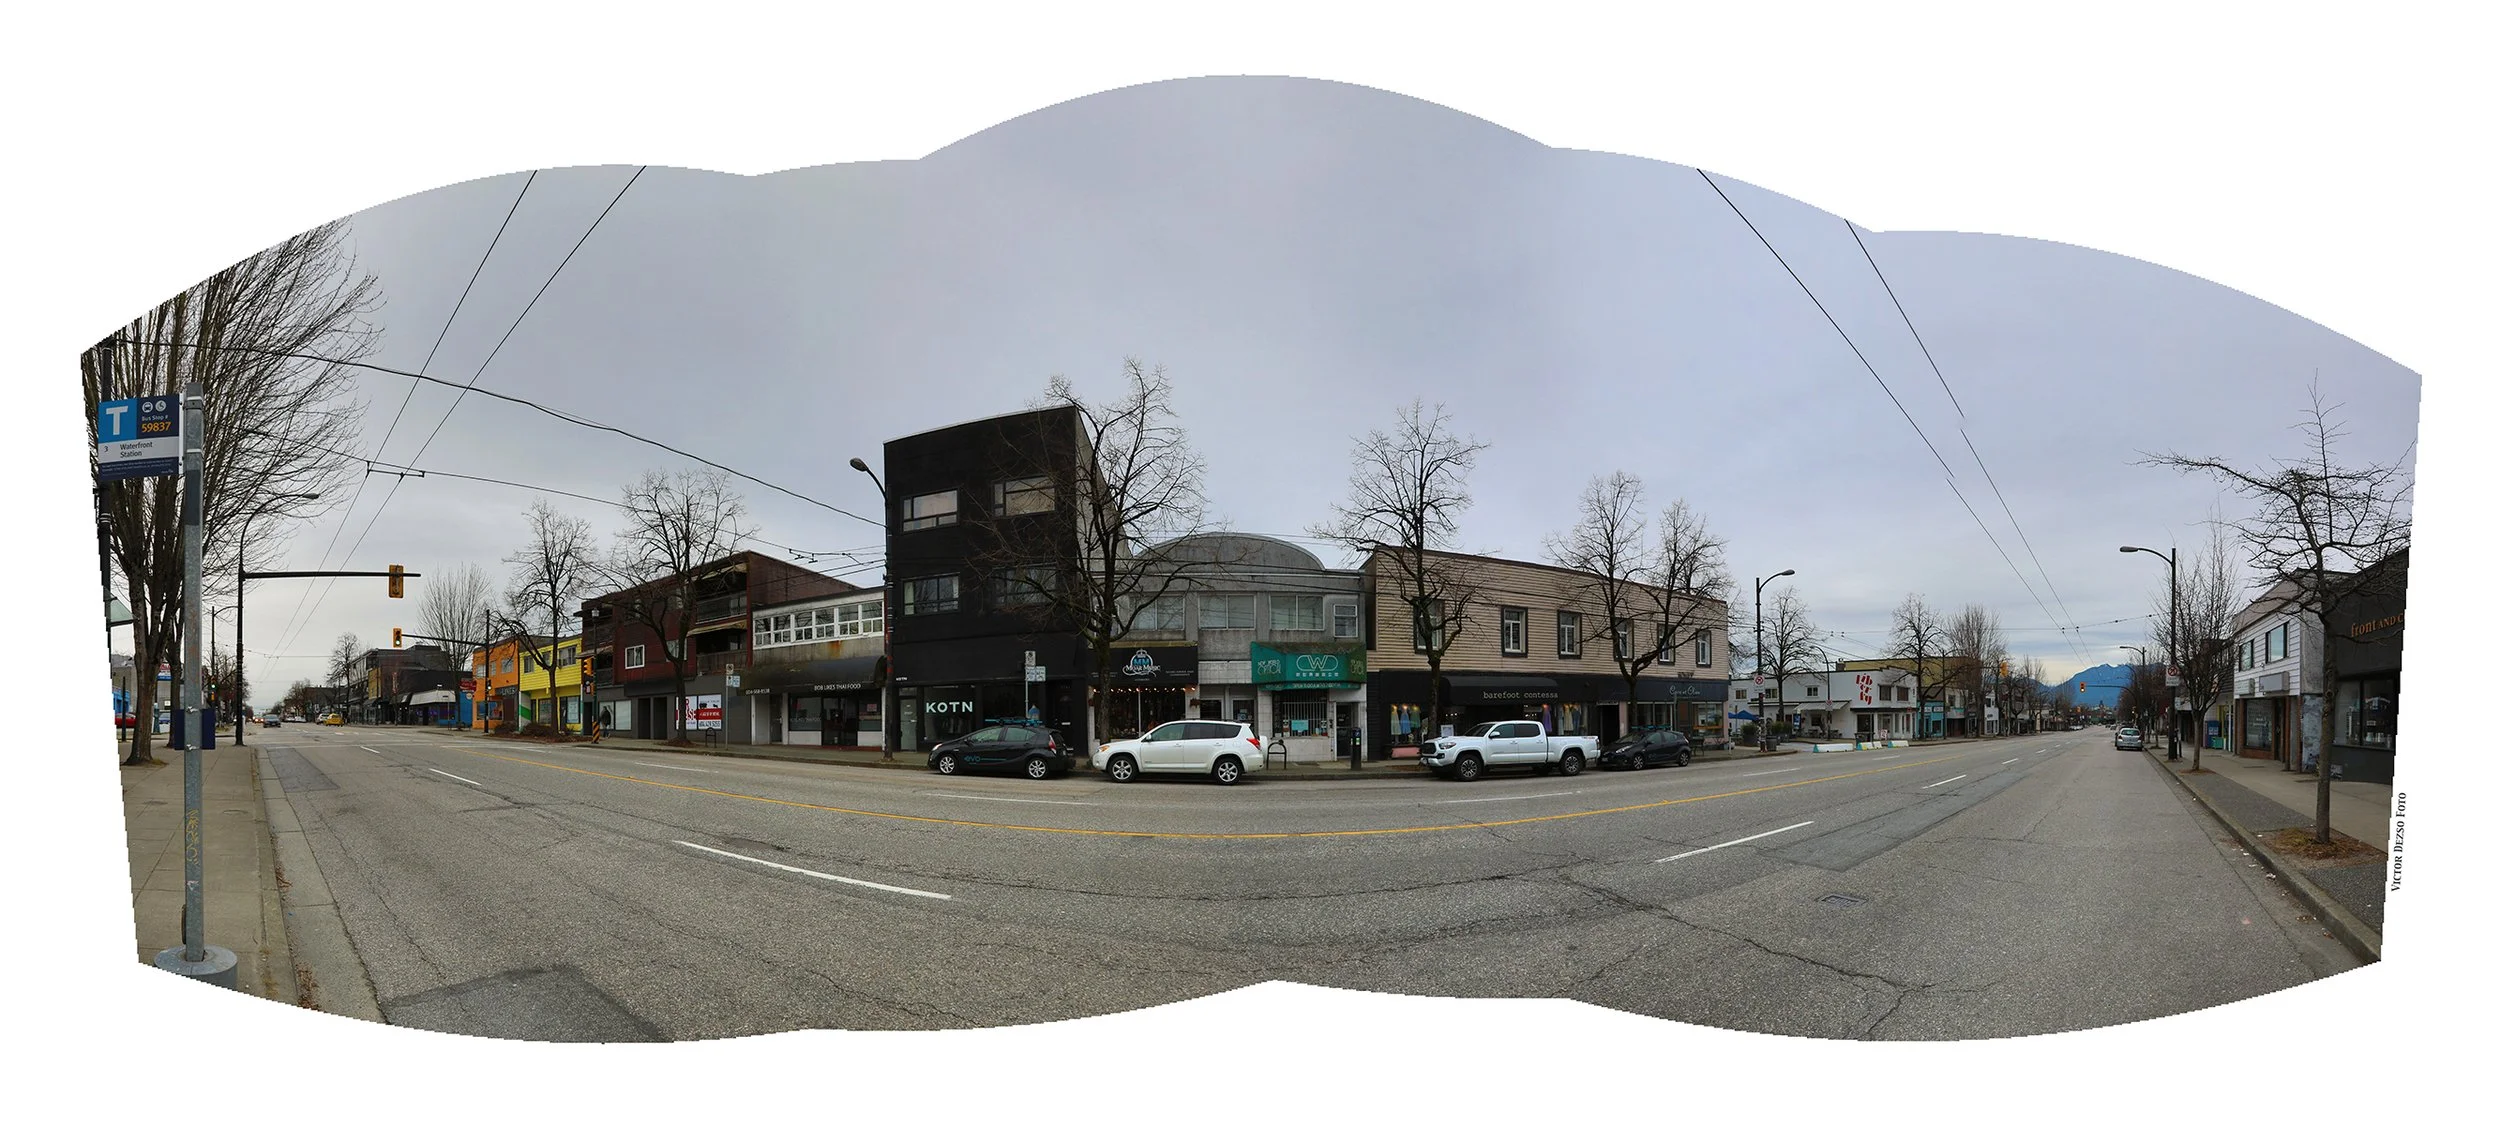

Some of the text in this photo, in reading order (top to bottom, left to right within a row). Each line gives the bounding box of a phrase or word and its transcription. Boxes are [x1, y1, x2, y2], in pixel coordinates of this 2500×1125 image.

[106, 405, 128, 435] T
[142, 421, 171, 433] 59837
[120, 441, 153, 450] Waterfront
[120, 450, 142, 458] Station
[847, 682, 861, 690] FOOD
[1483, 691, 1520, 699] barefoot
[926, 701, 973, 713] KOTN
